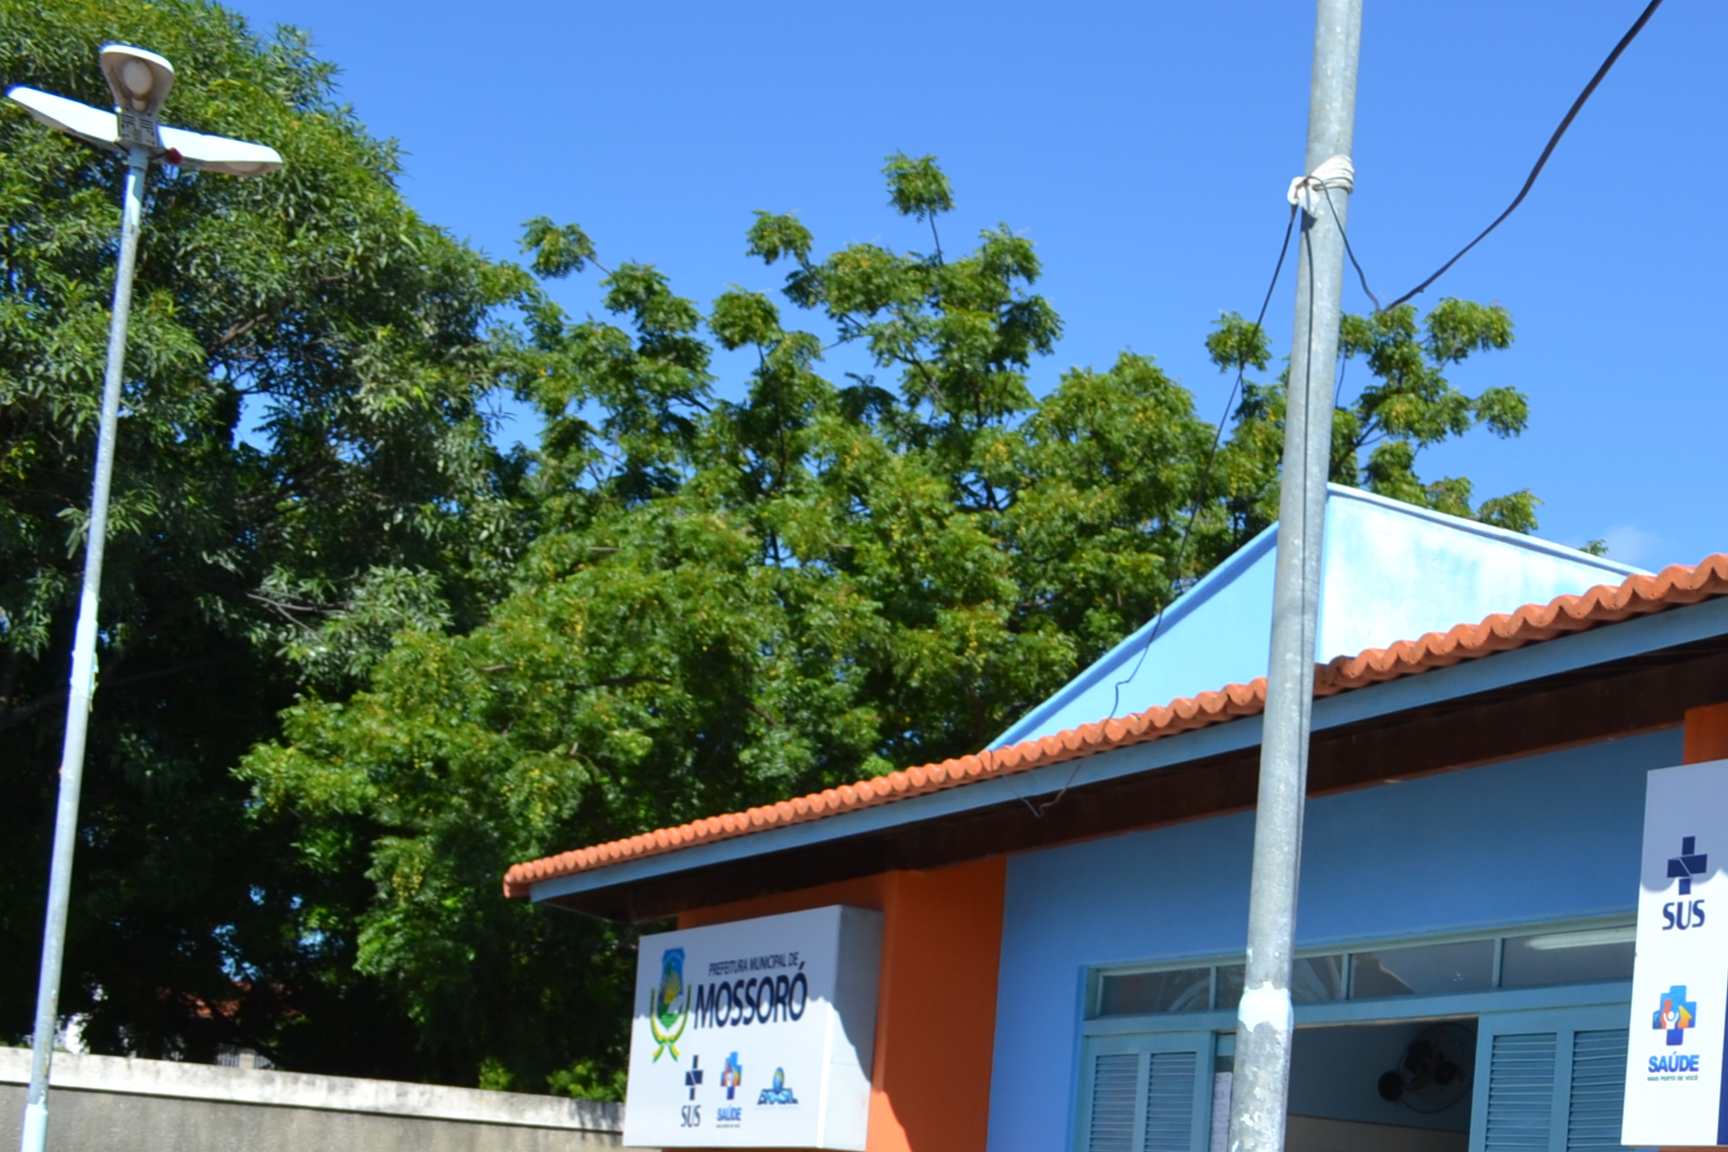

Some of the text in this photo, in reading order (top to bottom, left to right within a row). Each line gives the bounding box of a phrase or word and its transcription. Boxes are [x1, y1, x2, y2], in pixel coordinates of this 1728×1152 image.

[1662, 898, 1706, 931] SUS
[708, 951, 799, 976] PREFEITURA MUNICIPAL DE
[694, 961, 808, 1030] MOSSORÓ
[1648, 1050, 1700, 1073] SAÚDE
[680, 1105, 701, 1128] SUS
[716, 1104, 741, 1121] SAÚDE
